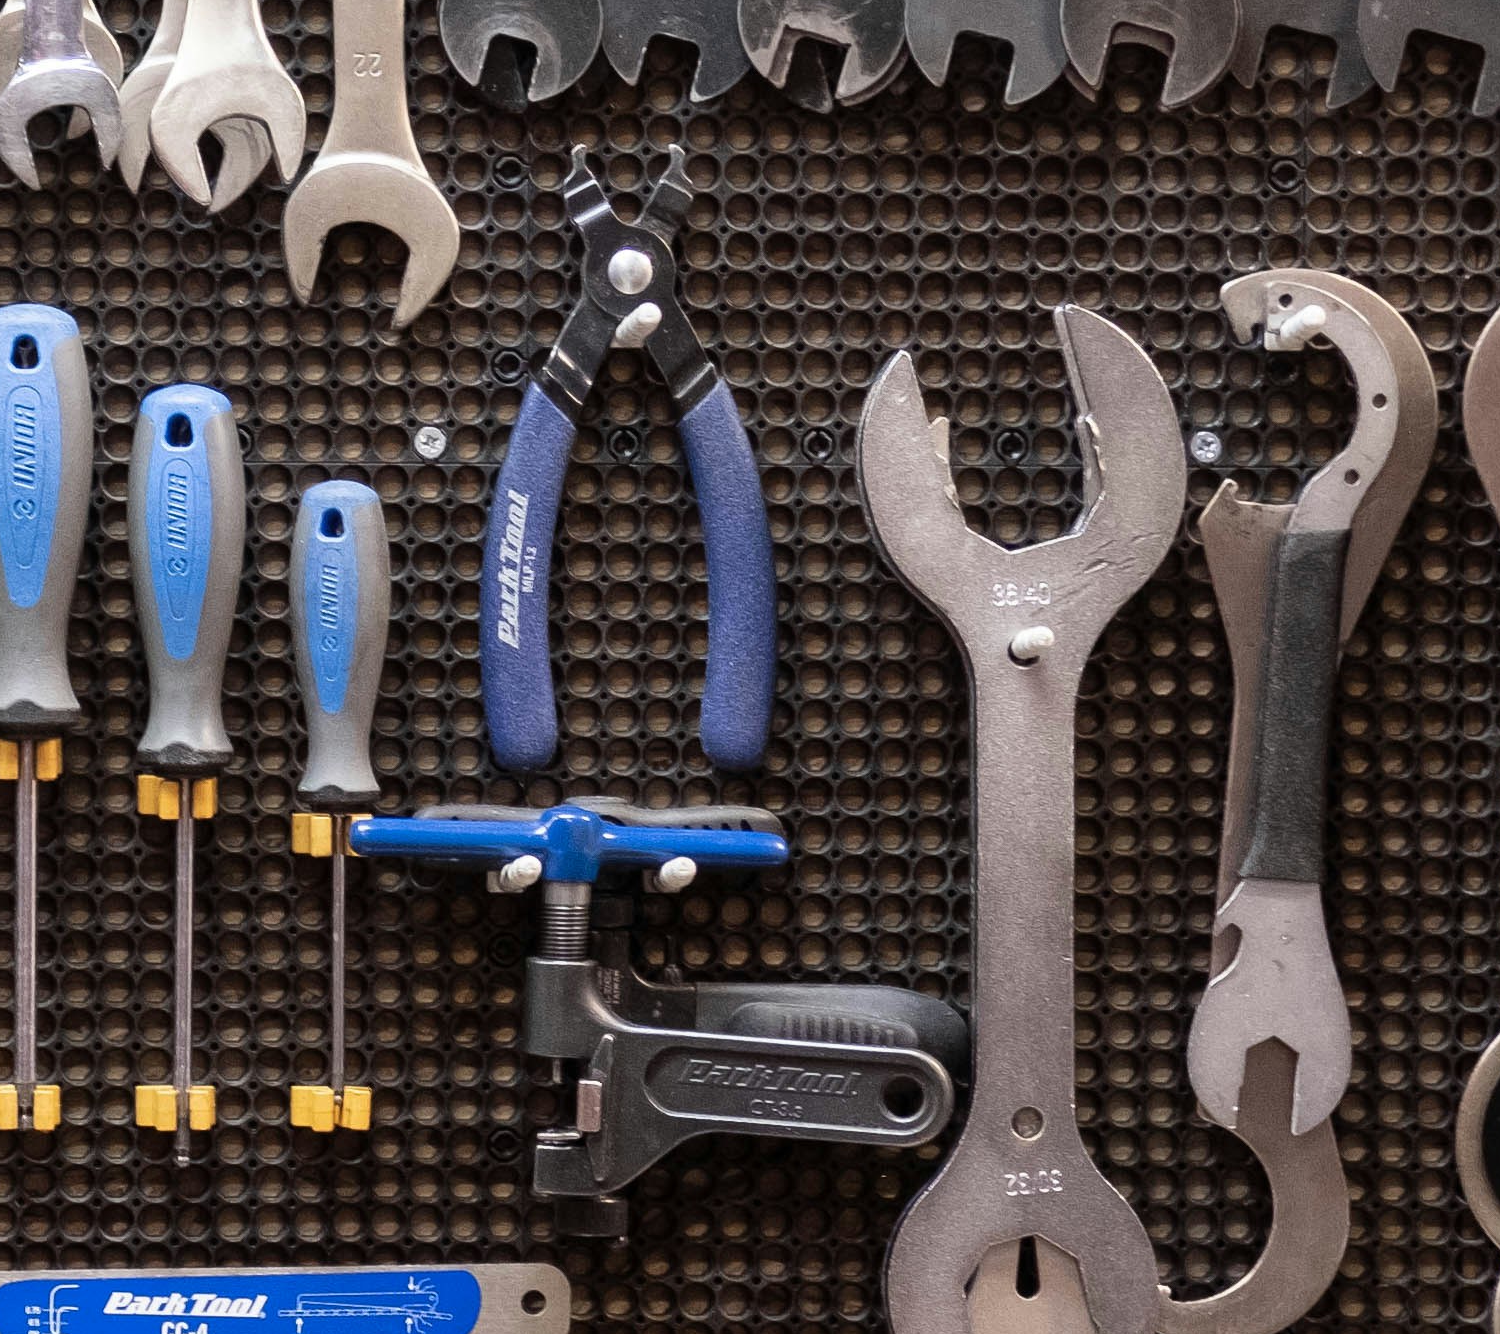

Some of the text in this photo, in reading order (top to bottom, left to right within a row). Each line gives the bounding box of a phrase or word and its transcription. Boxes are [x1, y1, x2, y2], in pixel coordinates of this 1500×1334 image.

[351, 50, 384, 77] 22
[13, 403, 37, 490] UNIOR
[167, 472, 188, 550] UNIOR
[320, 564, 339, 629] UNIOR
